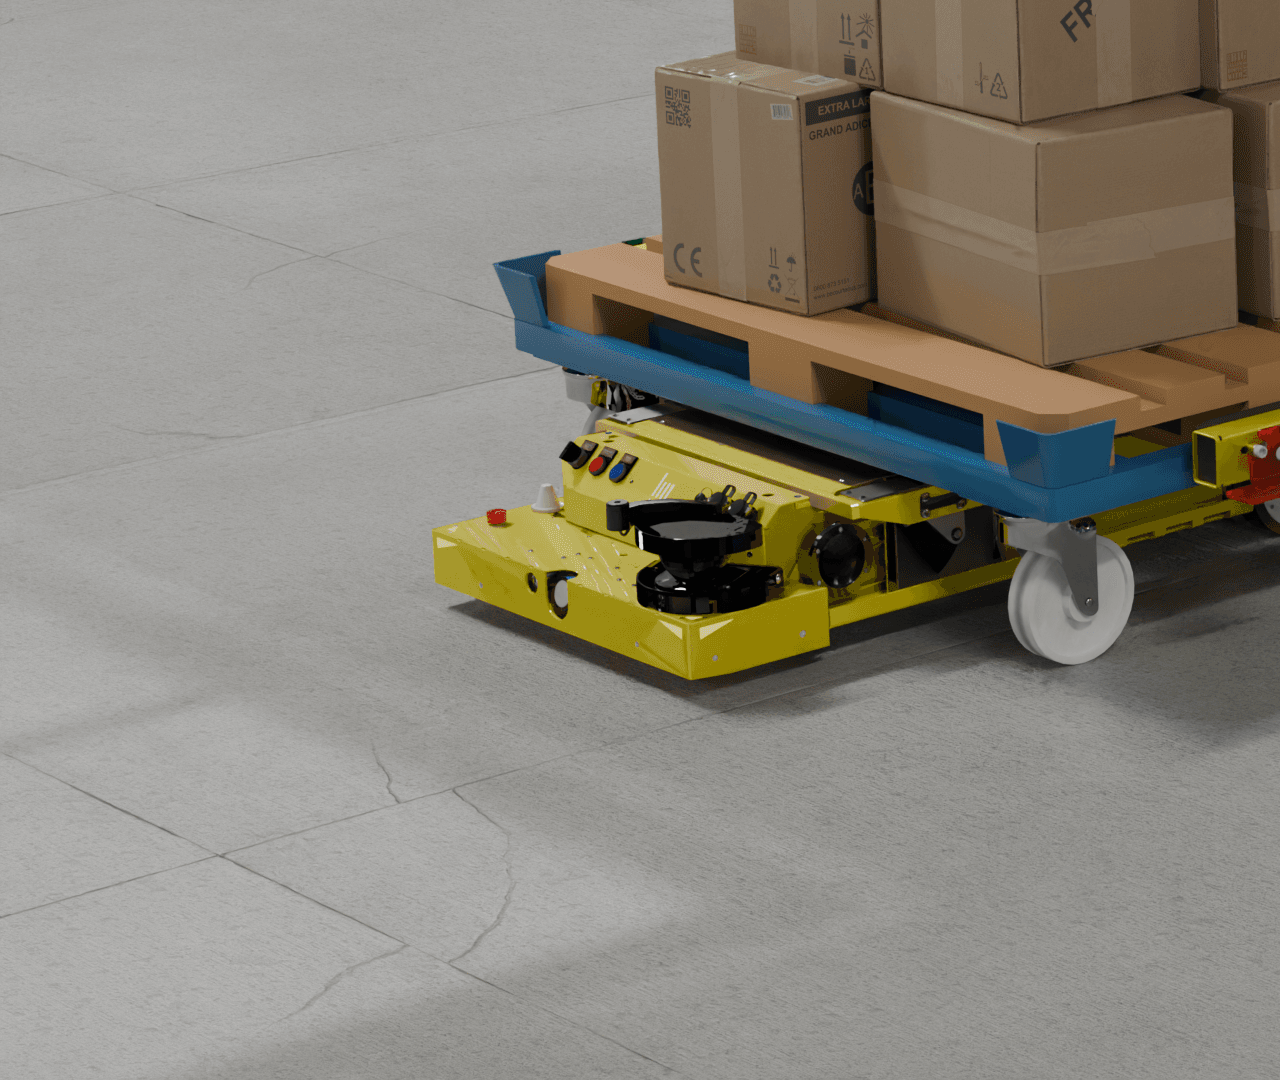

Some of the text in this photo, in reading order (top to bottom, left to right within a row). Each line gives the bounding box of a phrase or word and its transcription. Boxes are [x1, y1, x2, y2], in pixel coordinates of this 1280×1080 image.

[818, 101, 850, 116] EXTRA
[809, 125, 843, 140] GRAND
[674, 242, 703, 277] CE
